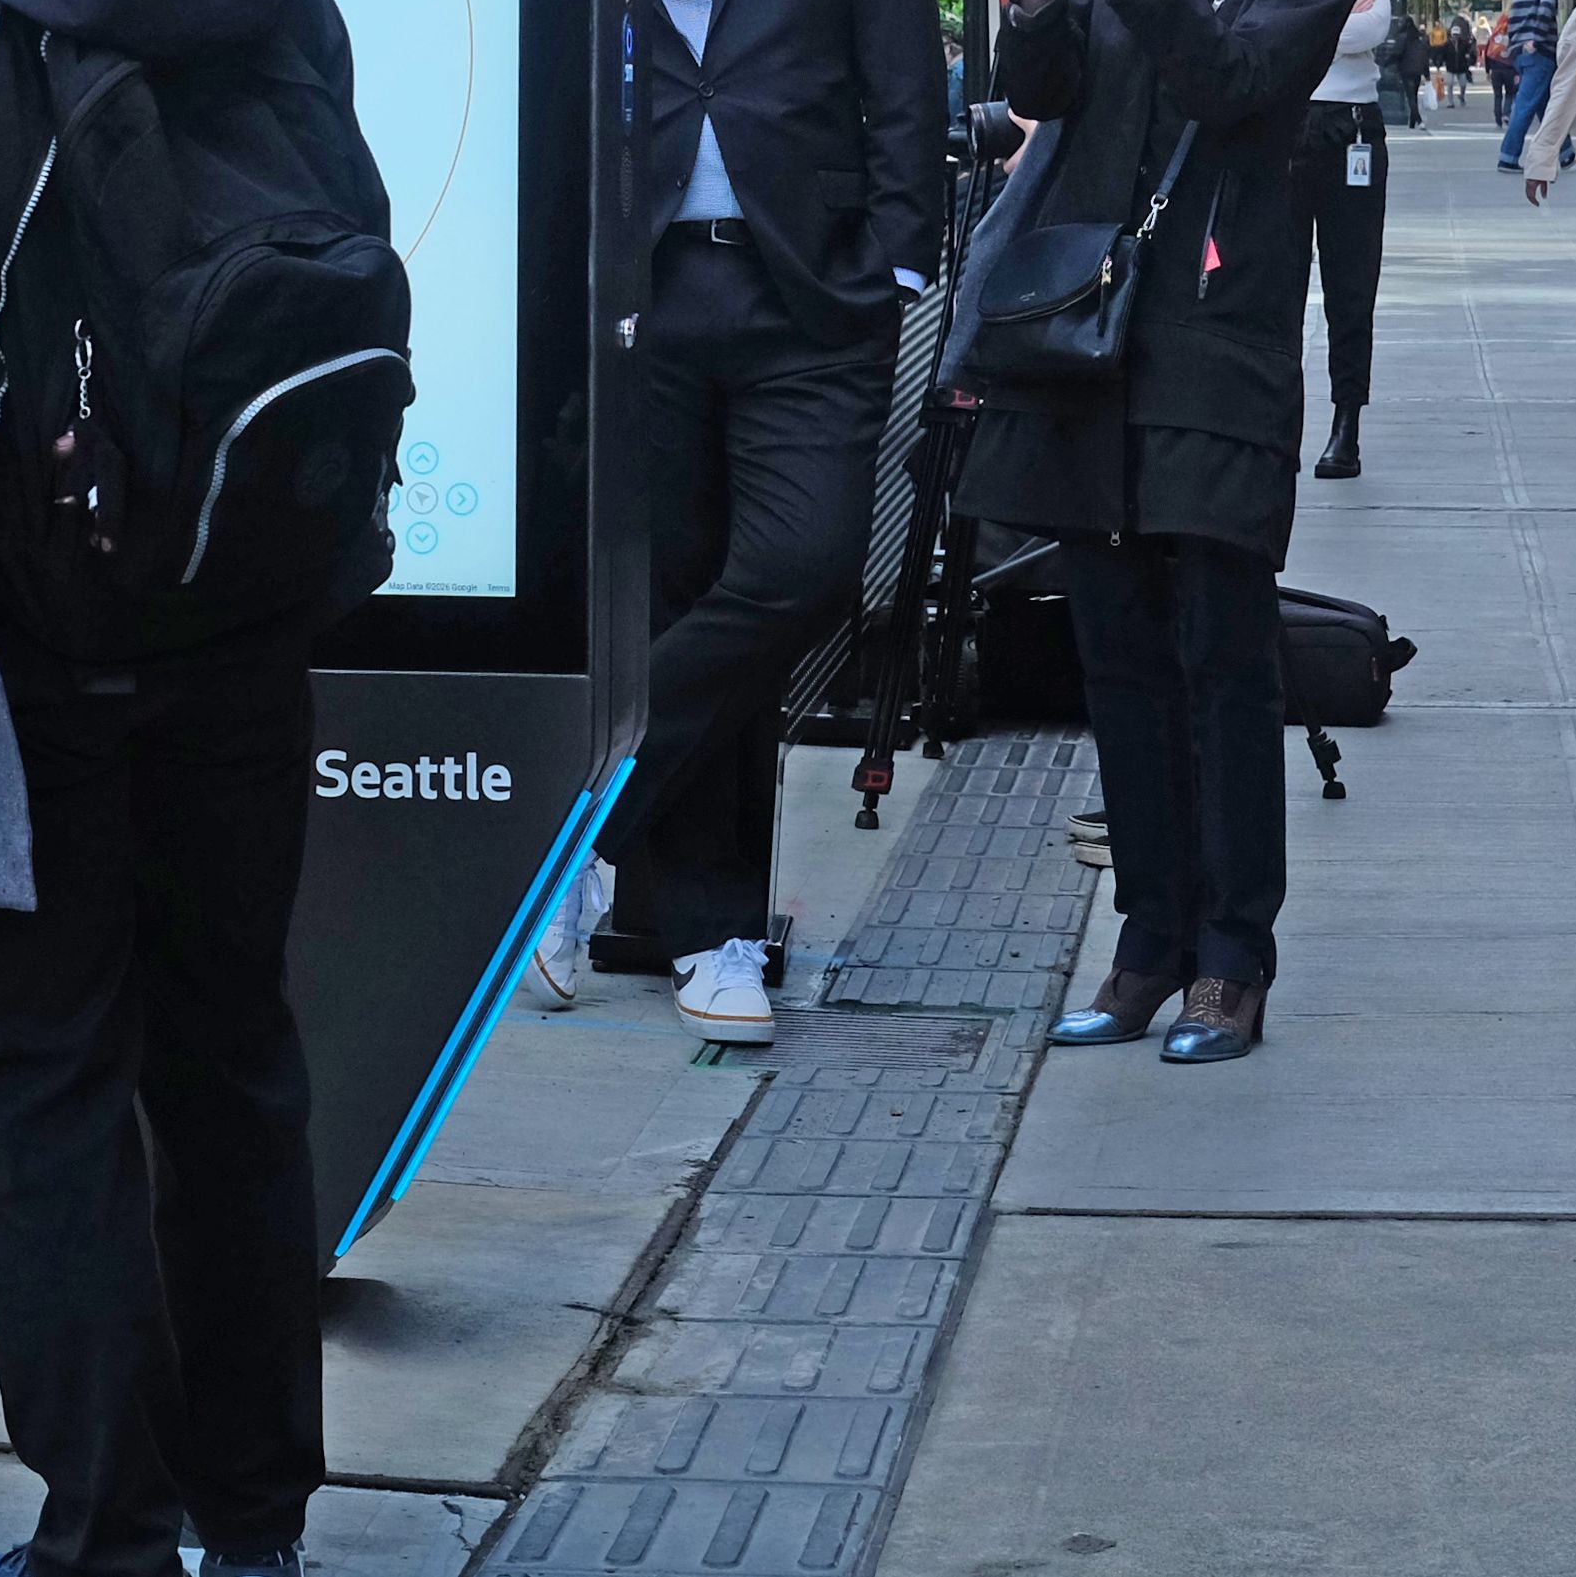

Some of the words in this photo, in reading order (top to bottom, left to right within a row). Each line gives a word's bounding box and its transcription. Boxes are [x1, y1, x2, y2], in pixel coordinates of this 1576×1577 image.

[388, 582, 405, 591] Map
[451, 582, 478, 593] Google
[486, 583, 511, 592] Terms
[315, 749, 512, 802] Seattle
